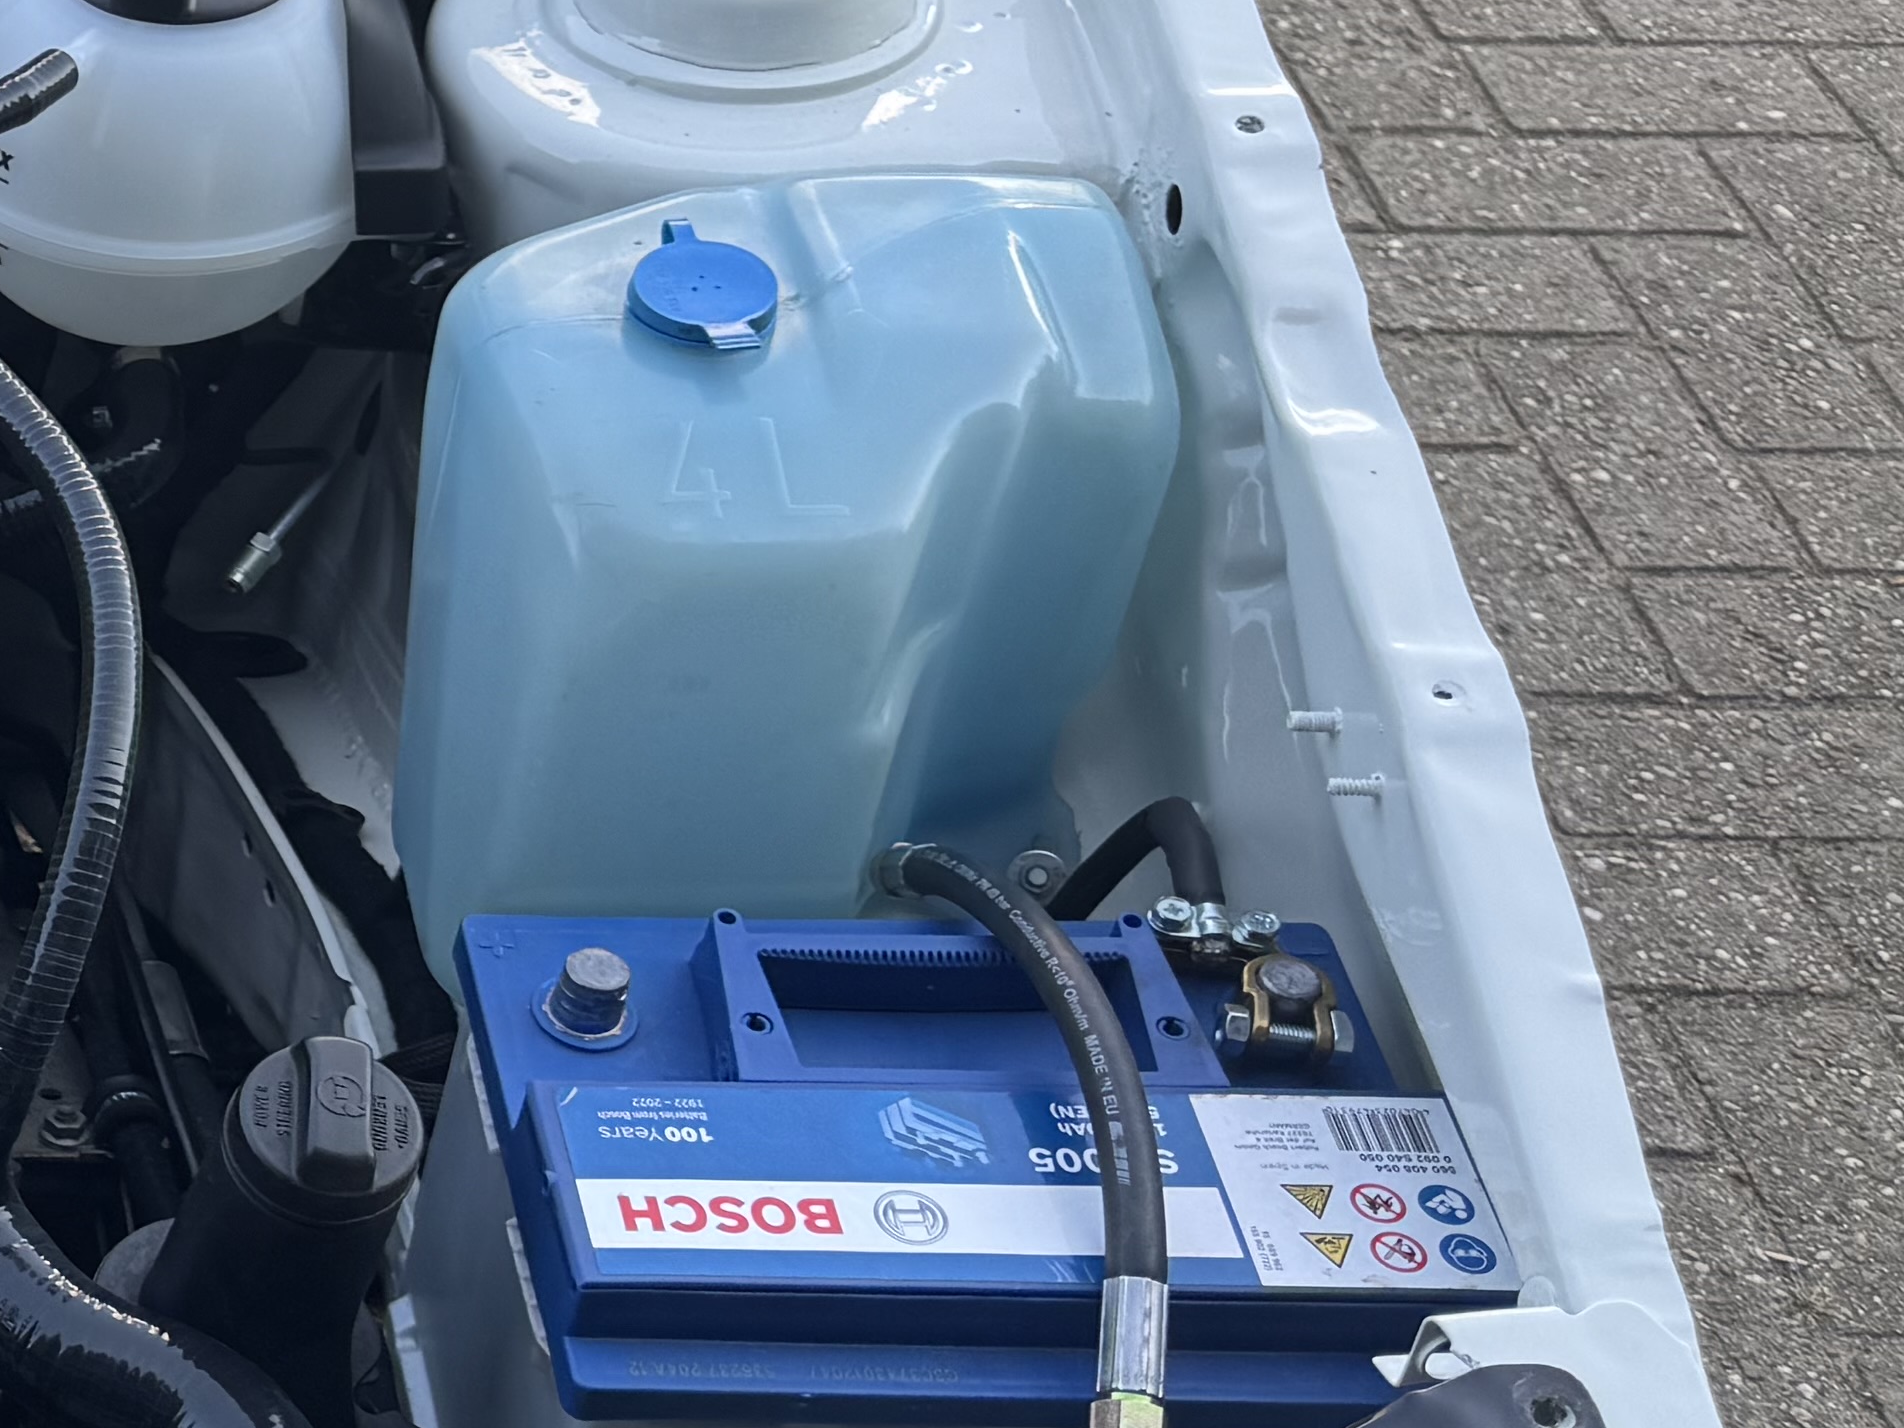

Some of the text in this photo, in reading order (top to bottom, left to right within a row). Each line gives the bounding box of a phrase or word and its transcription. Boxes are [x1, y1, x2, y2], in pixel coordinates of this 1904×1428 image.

[1082, 1032, 1110, 1075] MADE
[1101, 1093, 1120, 1115] EU
[1049, 1100, 1089, 1119] EN)
[597, 1126, 715, 1144] 100 Years
[617, 1192, 844, 1236] BOSCH
